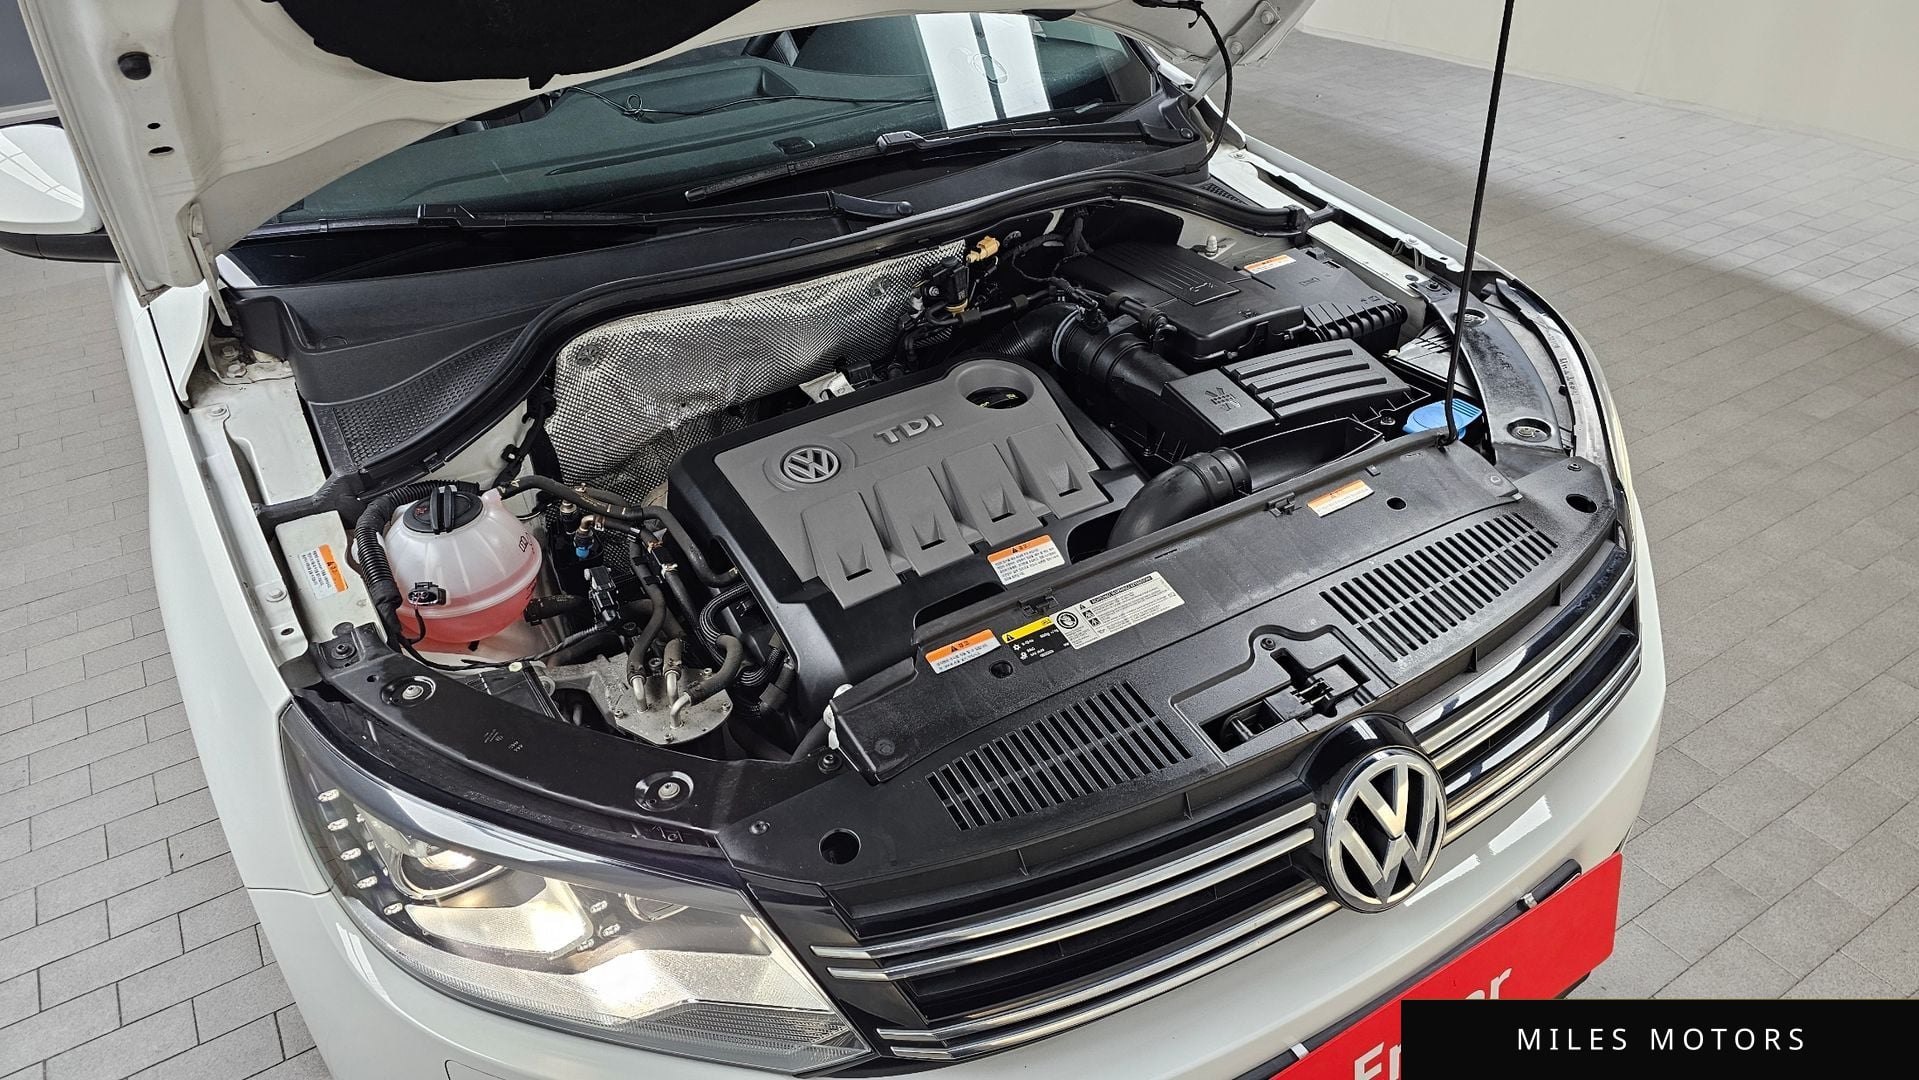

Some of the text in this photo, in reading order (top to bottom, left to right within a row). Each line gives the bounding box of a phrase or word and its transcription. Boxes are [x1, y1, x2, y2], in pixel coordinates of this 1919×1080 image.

[873, 413, 945, 444] TDI
[783, 447, 839, 482] VW
[1325, 747, 1447, 912] VW
